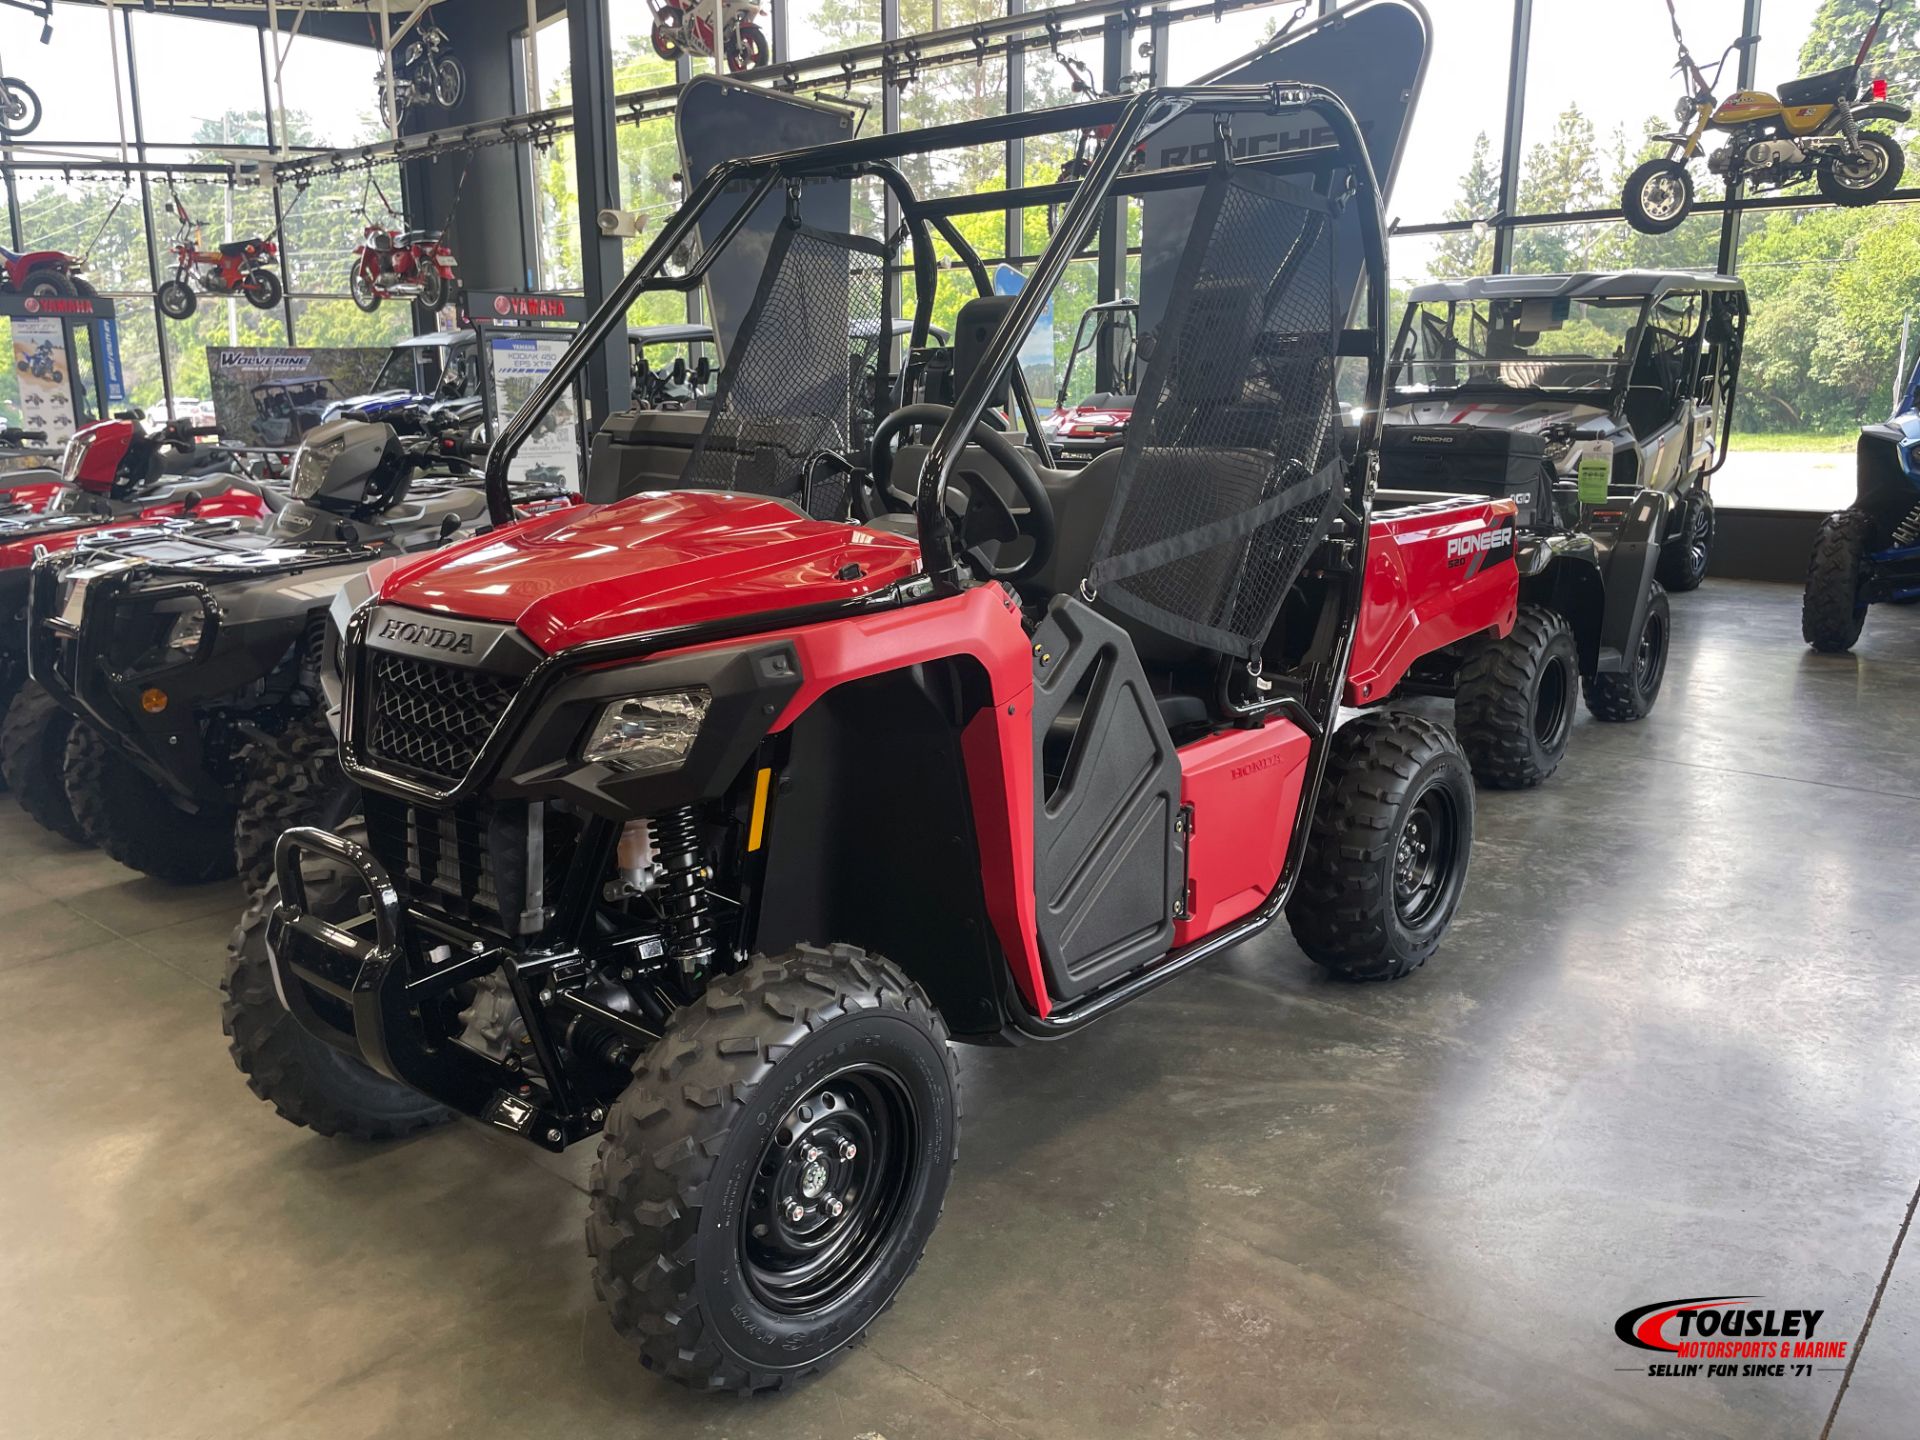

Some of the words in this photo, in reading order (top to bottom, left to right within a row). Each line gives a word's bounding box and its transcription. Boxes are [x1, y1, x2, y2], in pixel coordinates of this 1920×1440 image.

[1161, 120, 1375, 170] RANCHE
[40, 300, 94, 313] YAMAHA
[511, 297, 566, 317] YAMAHA
[508, 352, 538, 360] KODIAK
[1447, 527, 1512, 559] PIONEER
[1447, 557, 1466, 569] 520
[379, 618, 475, 655] HONDA
[1231, 754, 1282, 781] HONDA
